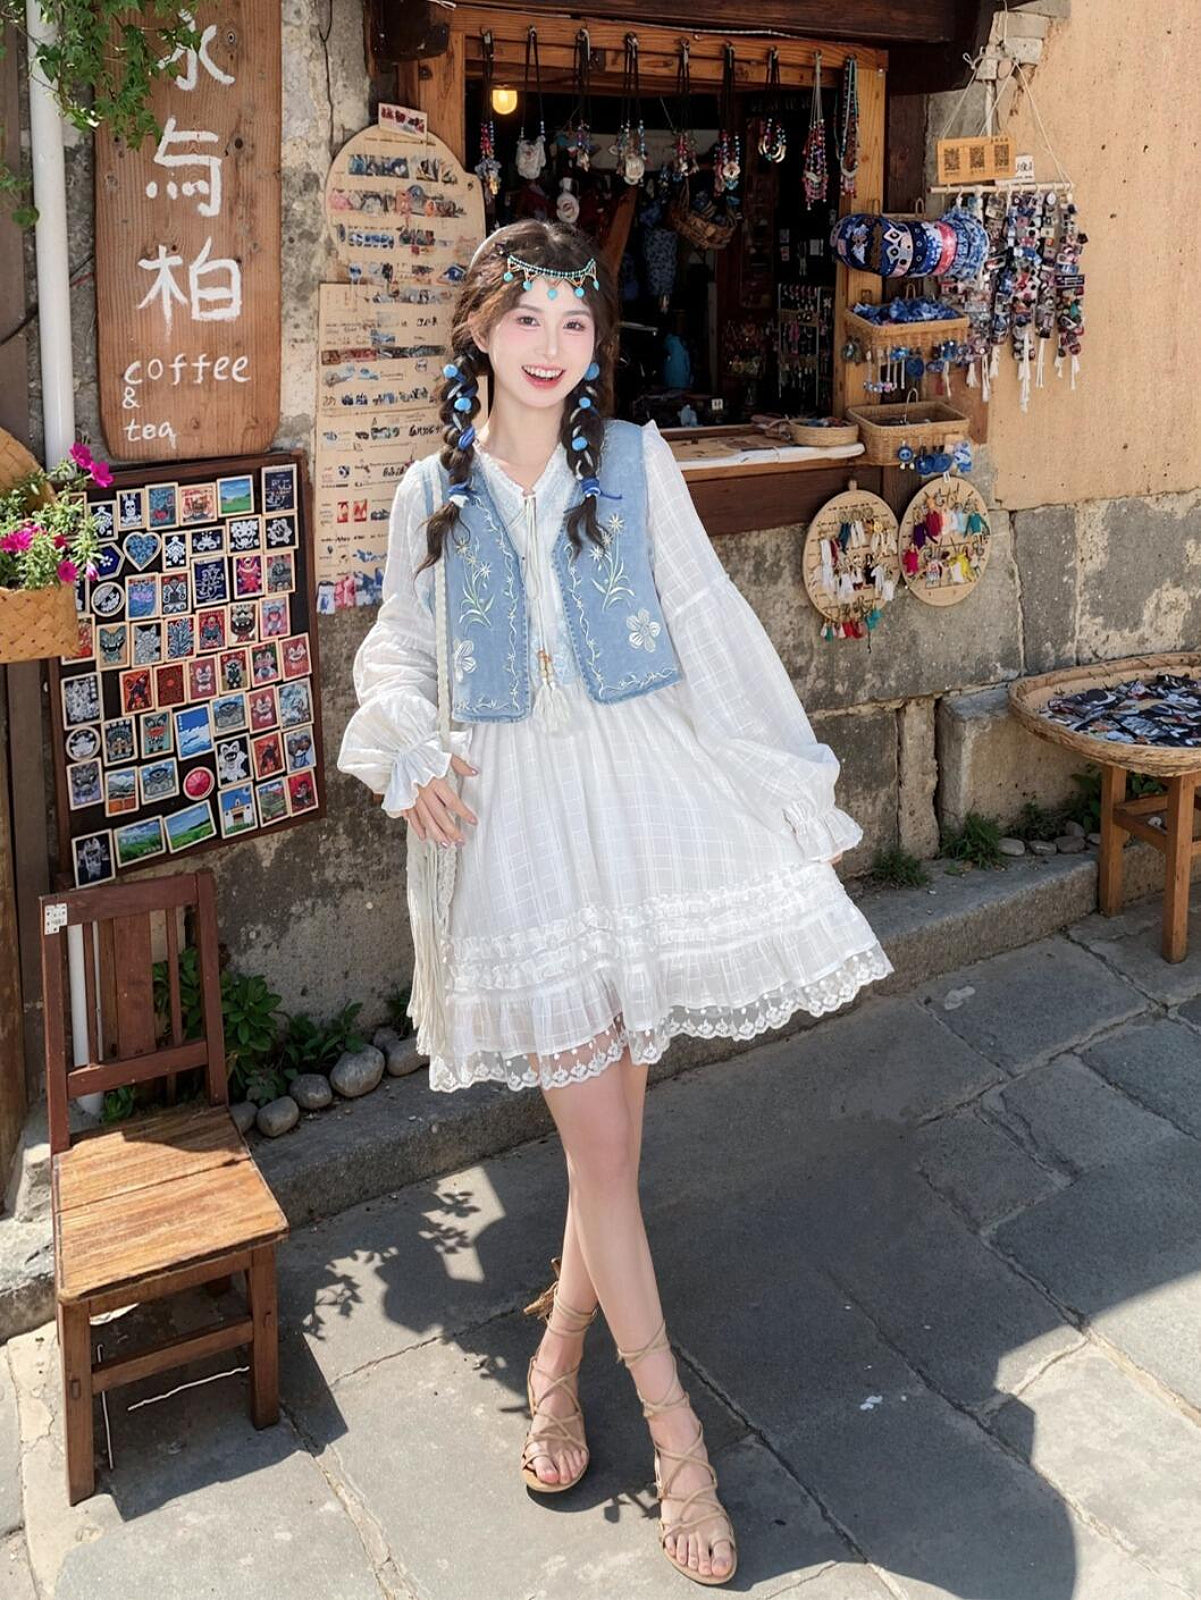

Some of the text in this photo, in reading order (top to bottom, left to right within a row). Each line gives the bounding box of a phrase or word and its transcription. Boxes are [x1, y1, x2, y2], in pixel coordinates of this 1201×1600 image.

[124, 353, 251, 385] coffee
[122, 386, 141, 409] &
[123, 418, 176, 449] tea
